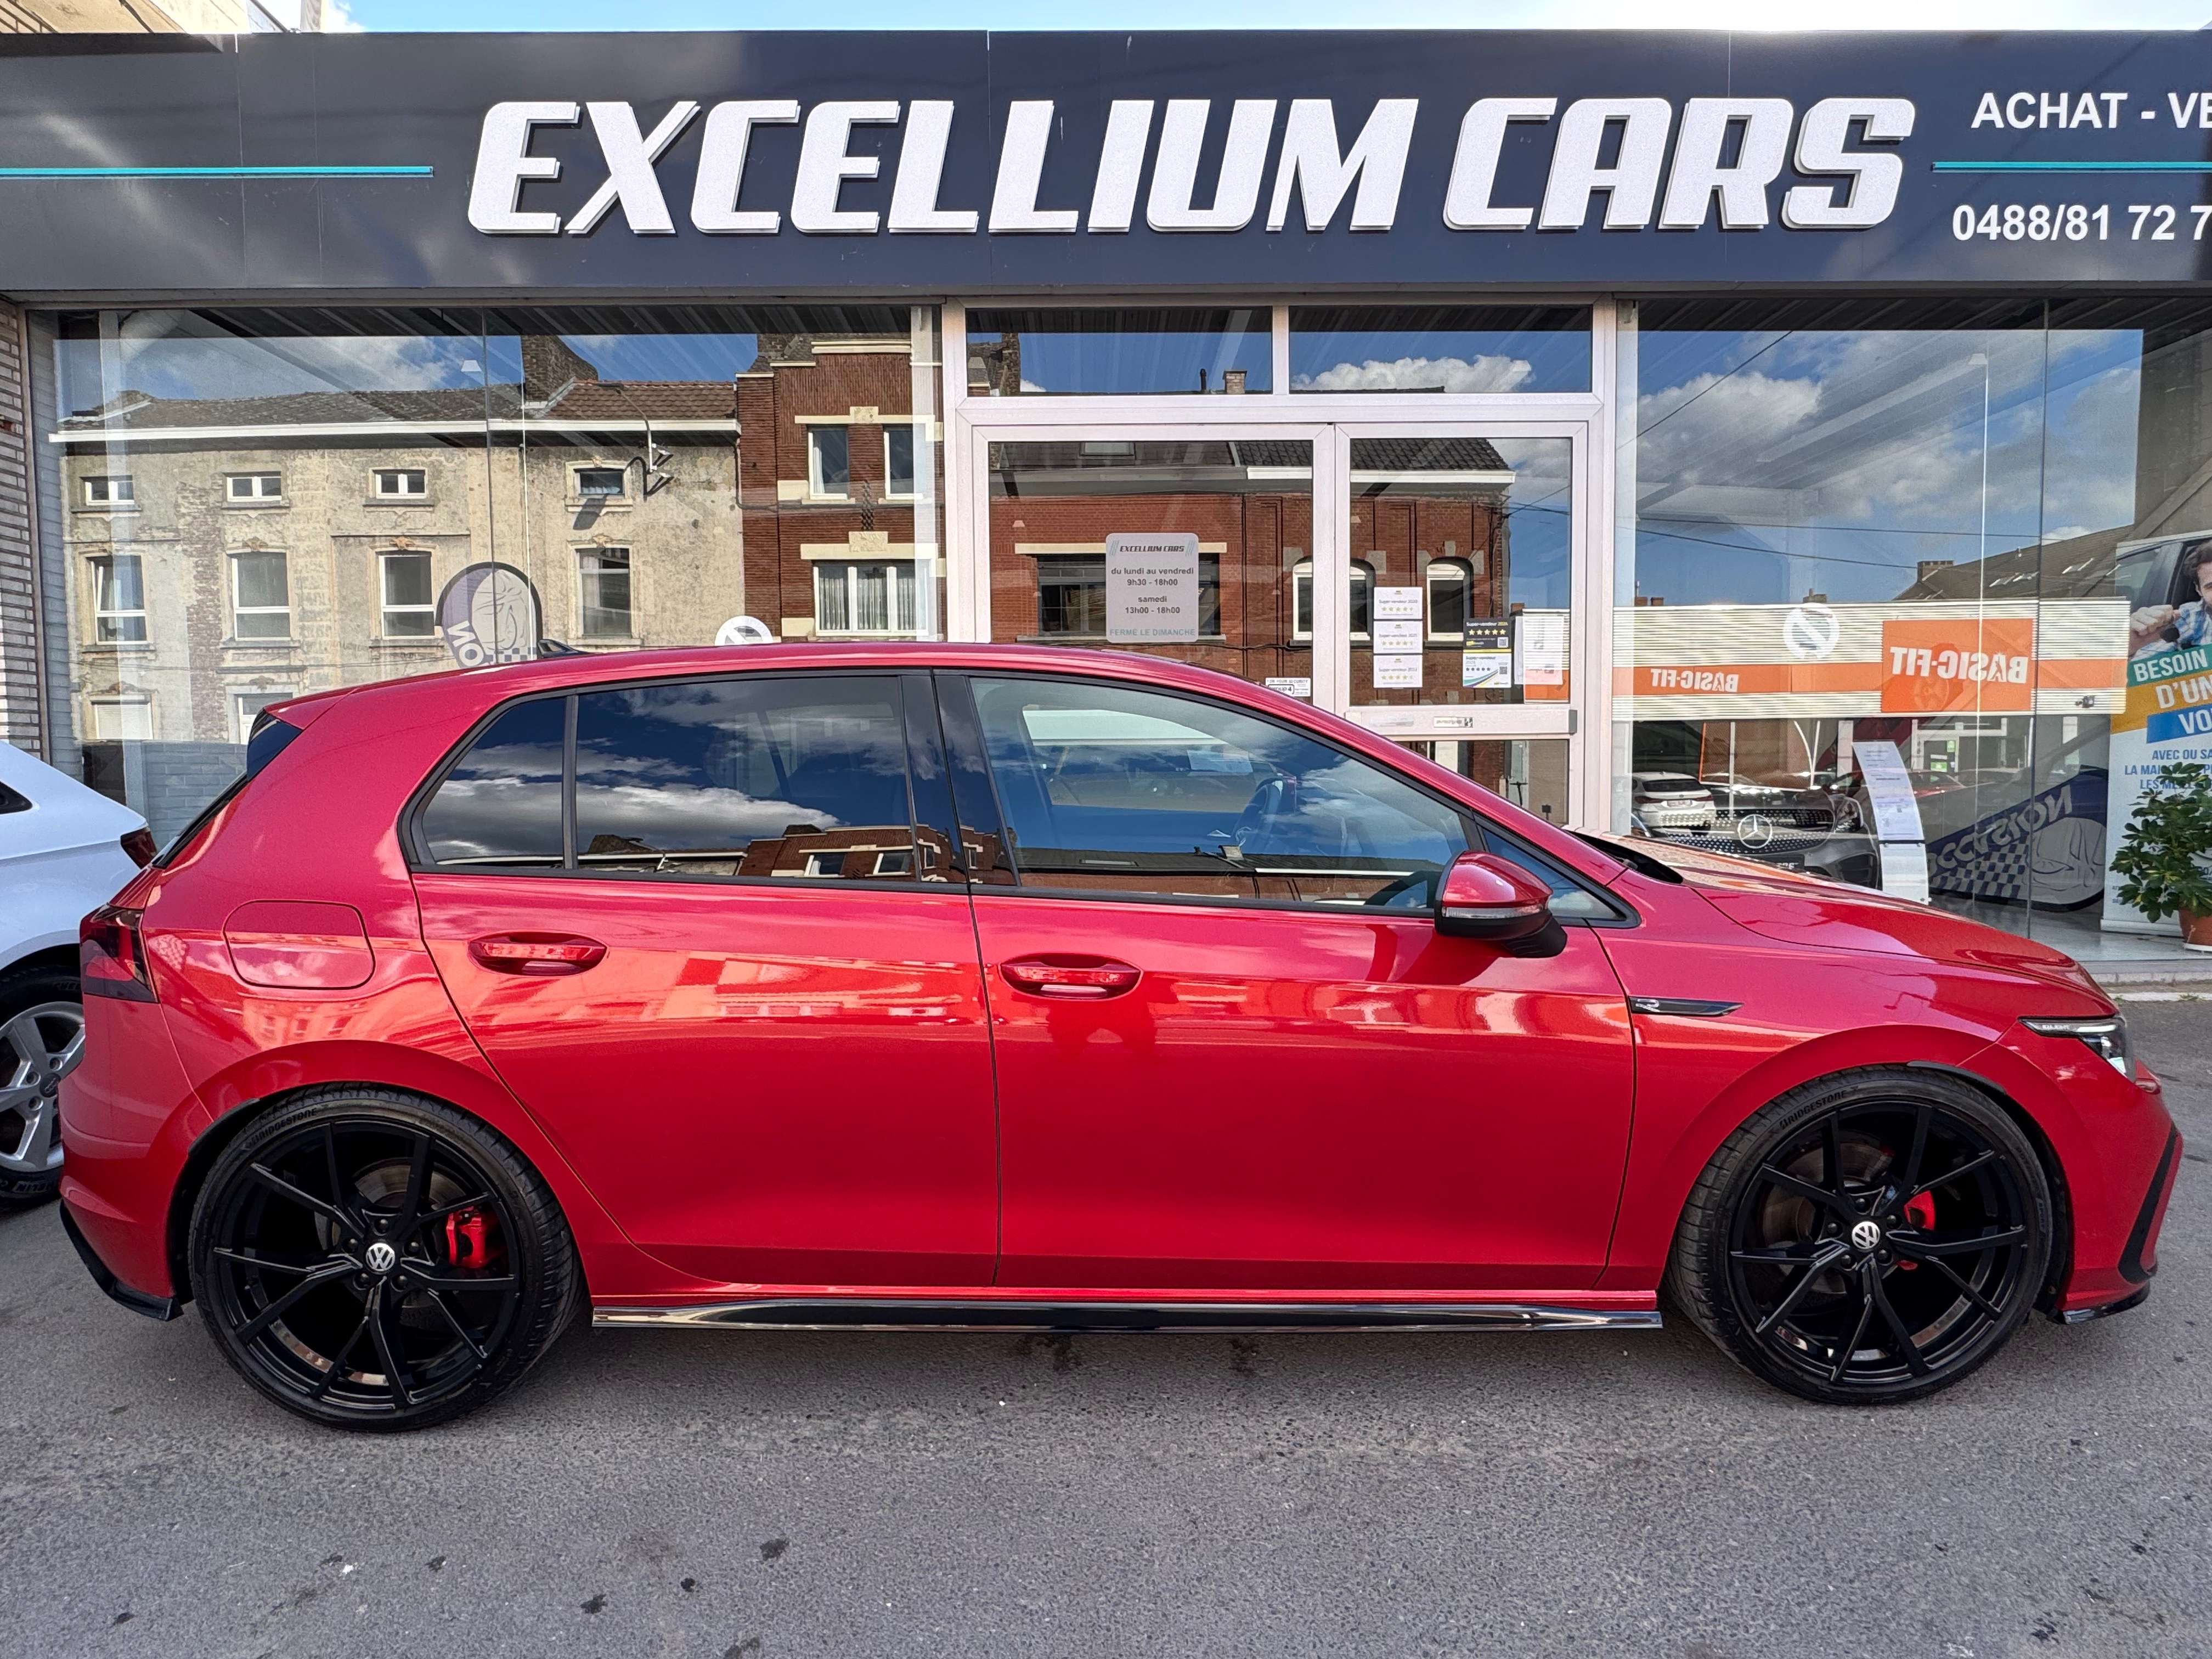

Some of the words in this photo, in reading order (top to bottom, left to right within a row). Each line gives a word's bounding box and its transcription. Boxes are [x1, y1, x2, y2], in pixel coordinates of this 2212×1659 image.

[1971, 92, 2128, 129] ACHAT
[2141, 110, 2155, 120] -
[468, 99, 1419, 234] EXCELLIUM
[1442, 97, 1916, 229] CARS
[1952, 204, 2109, 241] 0488/81
[2128, 205, 2176, 241] 72
[2190, 205, 2212, 241] 7
[2134, 648, 2208, 682] BESOIN
[2177, 708, 2212, 734] VO
[2124, 765, 2138, 775] LA
[2152, 749, 2180, 760] AVEC
[2182, 749, 2197, 760] OU
[2140, 779, 2159, 789] LES
[1779, 1090, 1847, 1130] BRIDGESTONE
